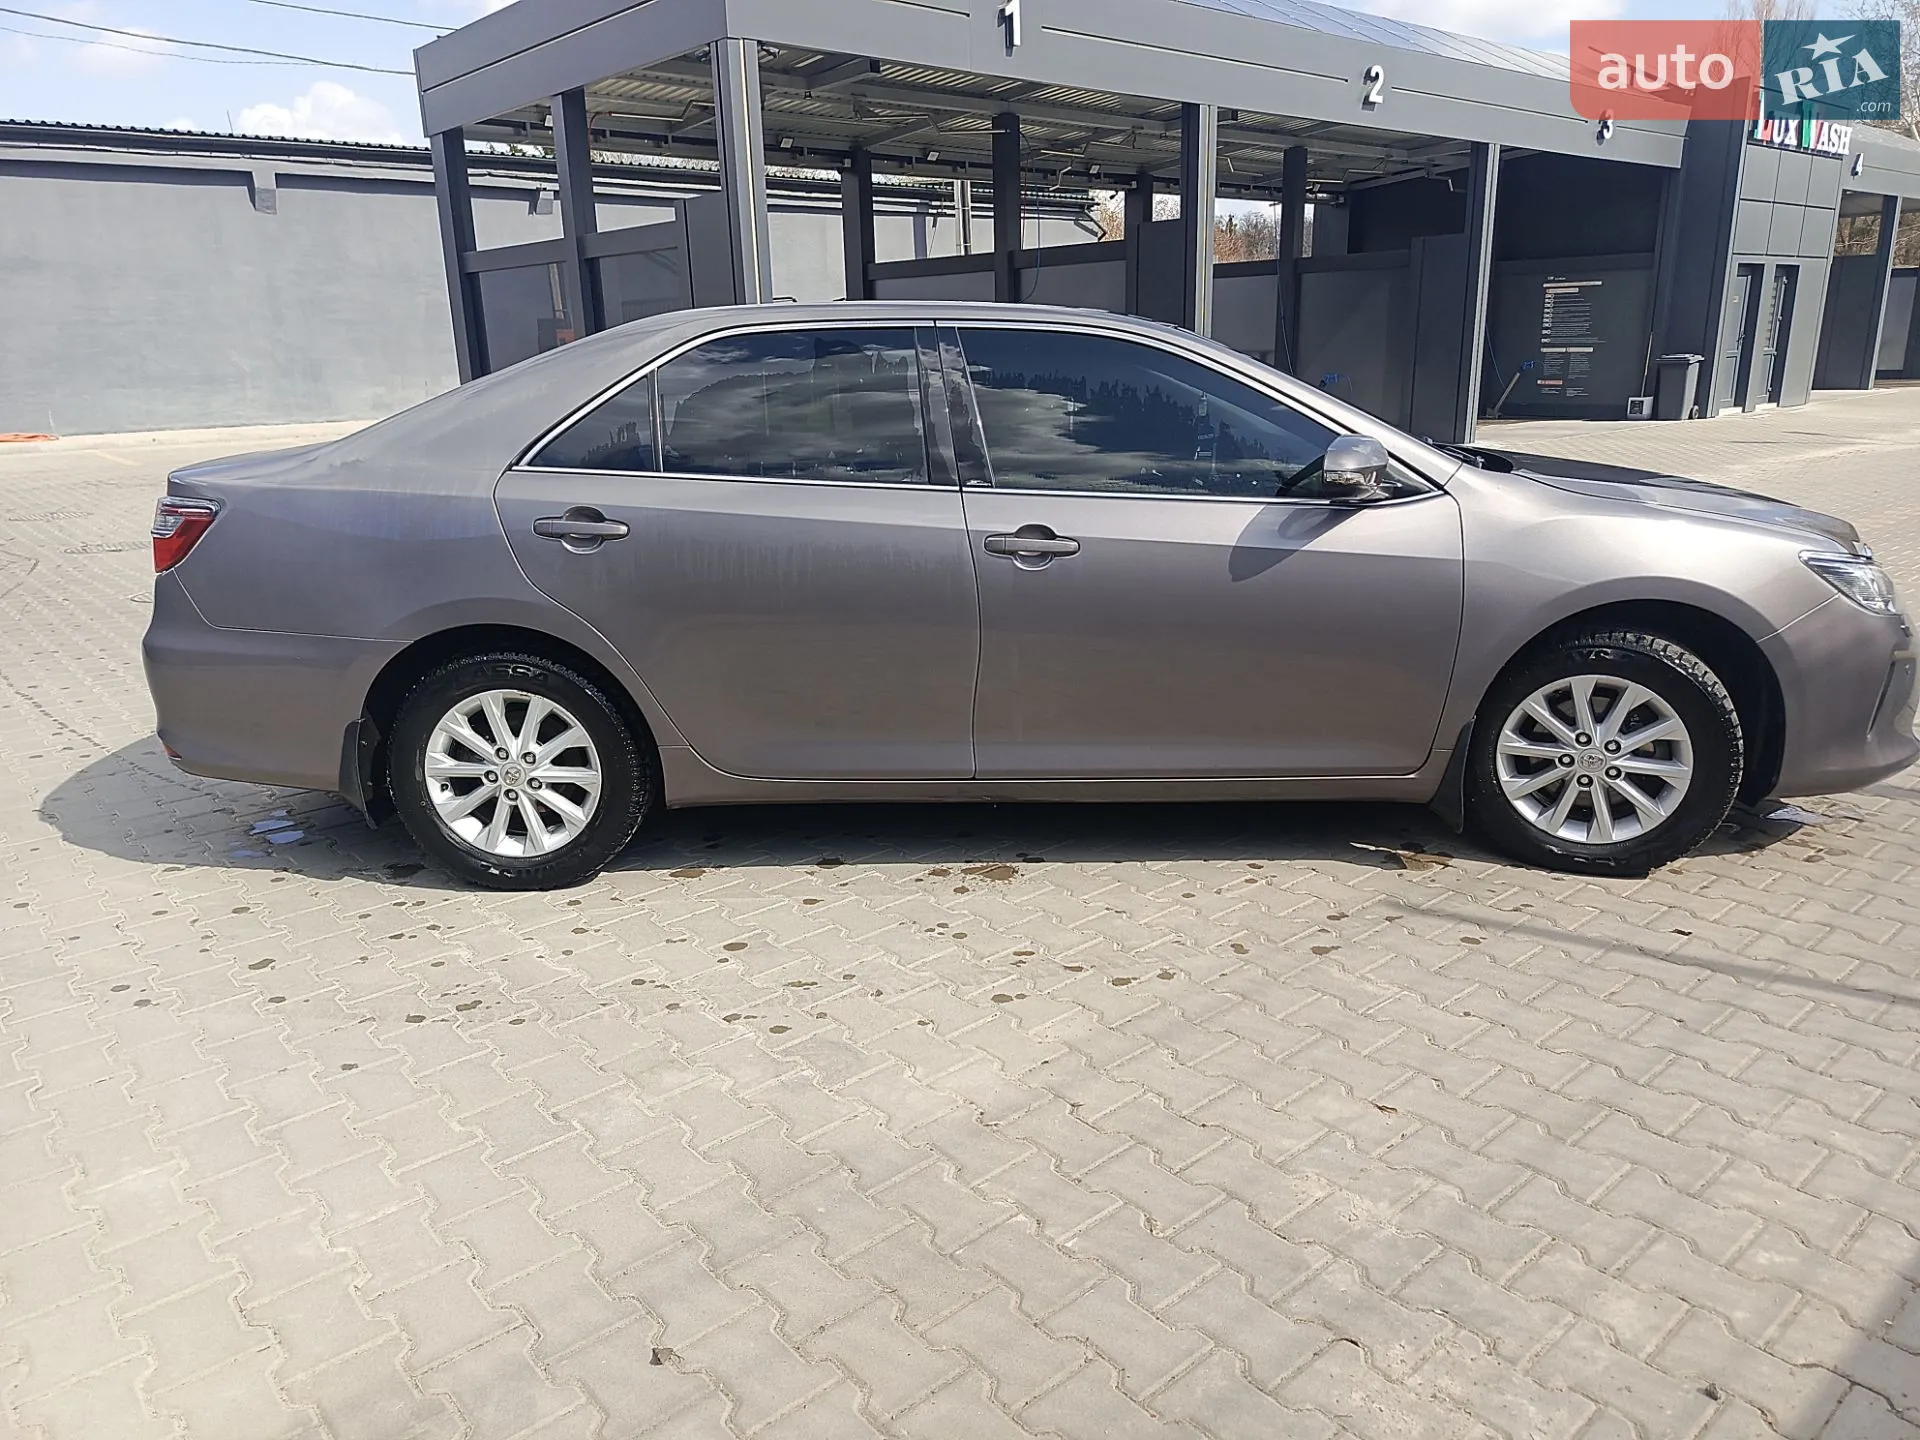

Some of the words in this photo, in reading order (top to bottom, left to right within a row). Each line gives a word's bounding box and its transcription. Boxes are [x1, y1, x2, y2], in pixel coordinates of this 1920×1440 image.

[1001, 0, 1021, 49] 1
[1366, 64, 1385, 106] 2
[1600, 109, 1614, 141] 3
